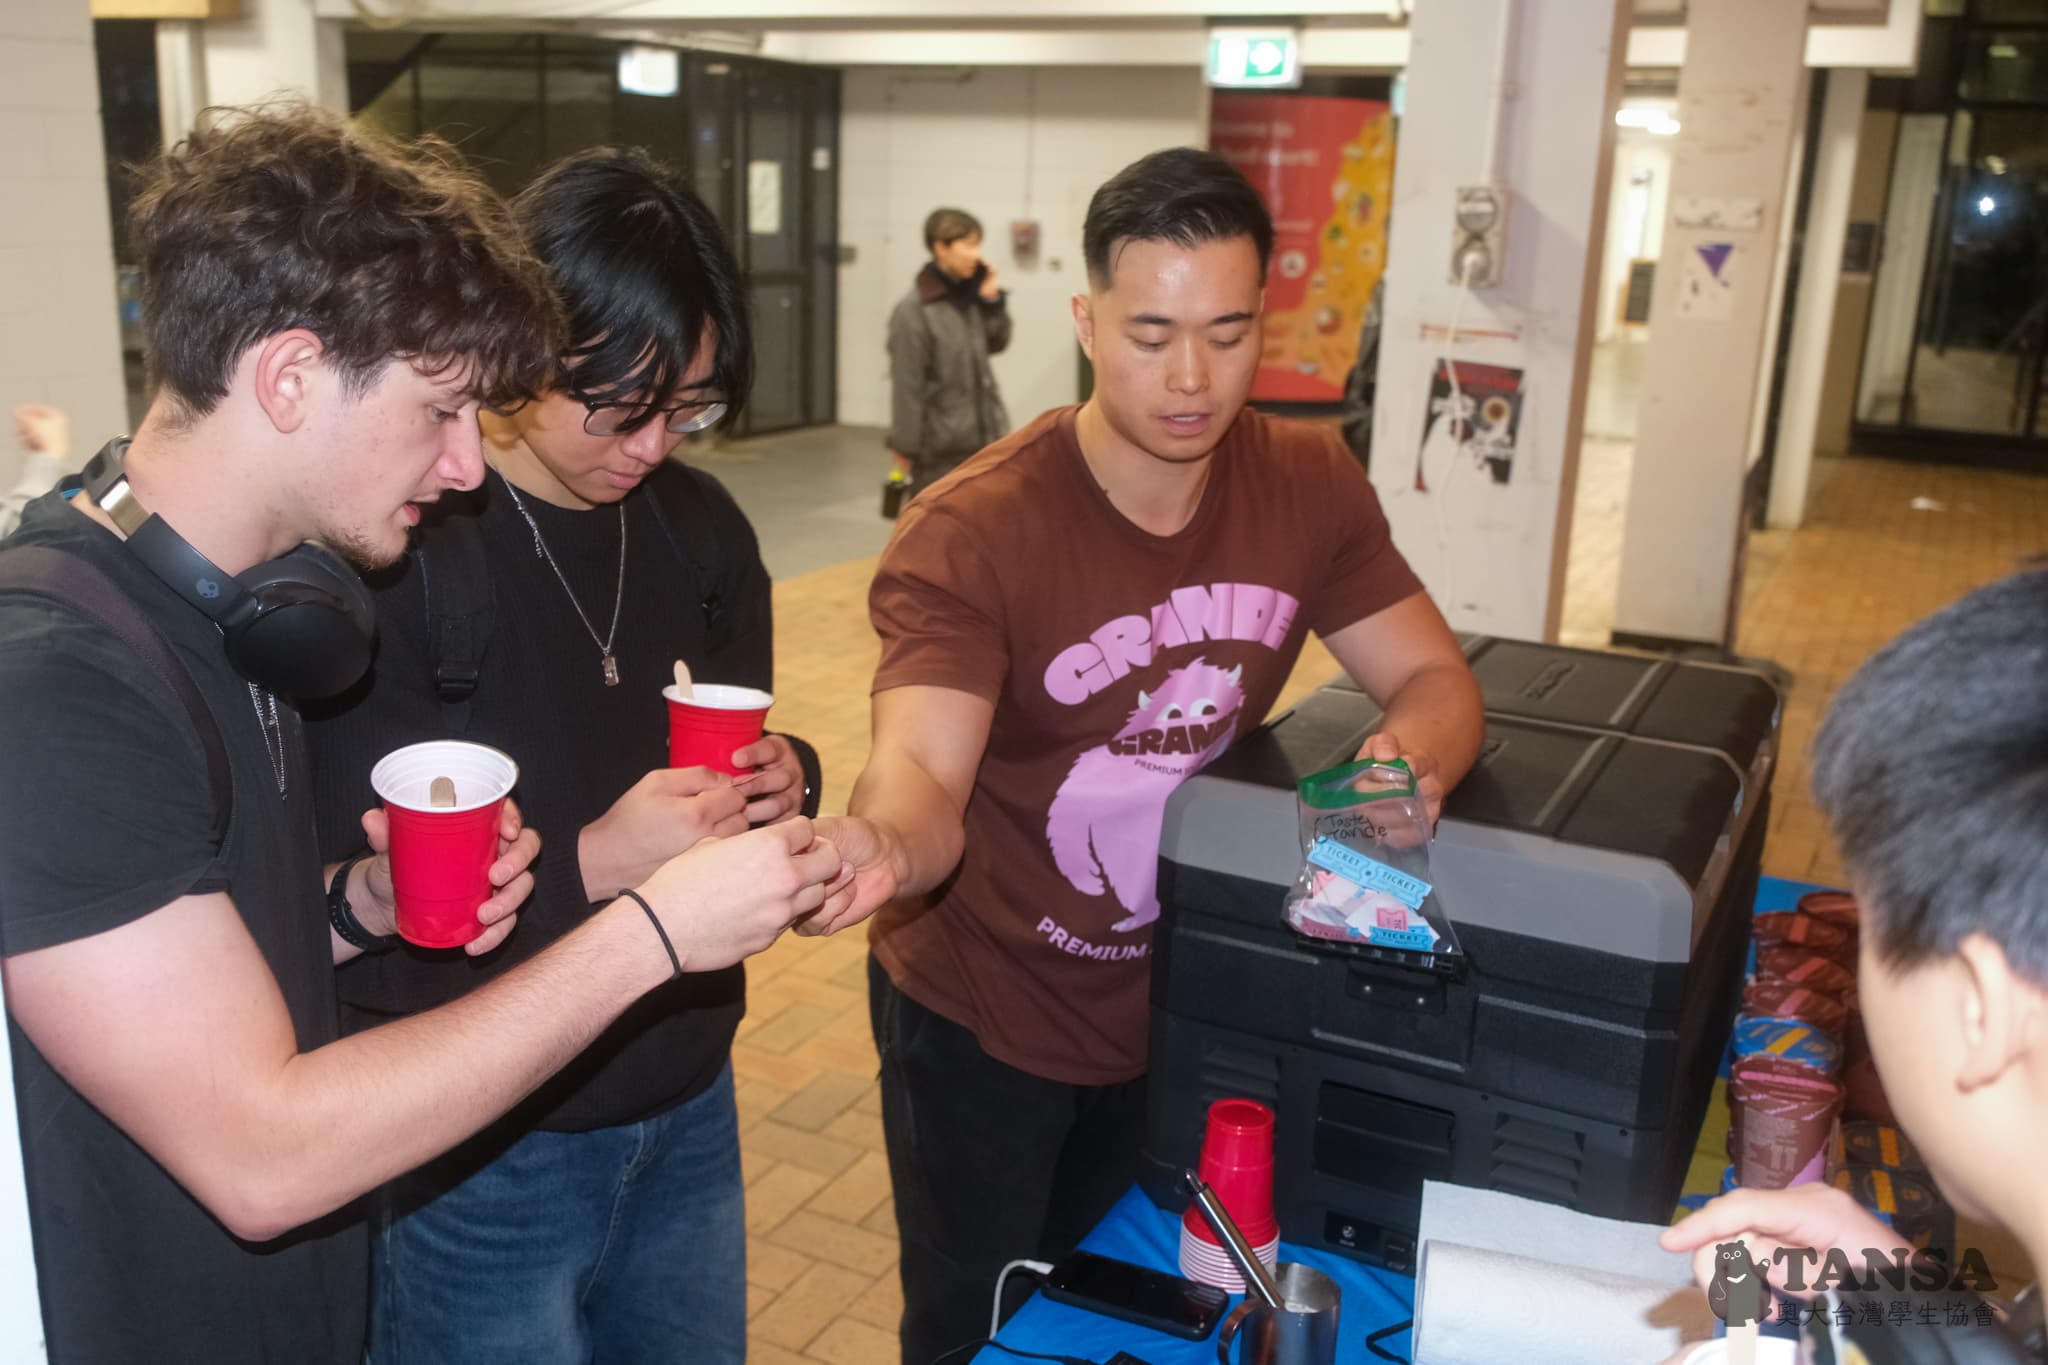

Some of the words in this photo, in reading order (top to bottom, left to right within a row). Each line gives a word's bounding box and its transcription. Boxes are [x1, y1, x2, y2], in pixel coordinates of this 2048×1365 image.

[1044, 582, 1299, 706] GRANDE
[1134, 758, 1183, 776] PREMIUM
[1327, 846, 1361, 867] TICKET
[1382, 870, 1417, 892] TICKET
[1036, 915, 1148, 961] PREMIUM
[1382, 930, 1419, 942] TICKET
